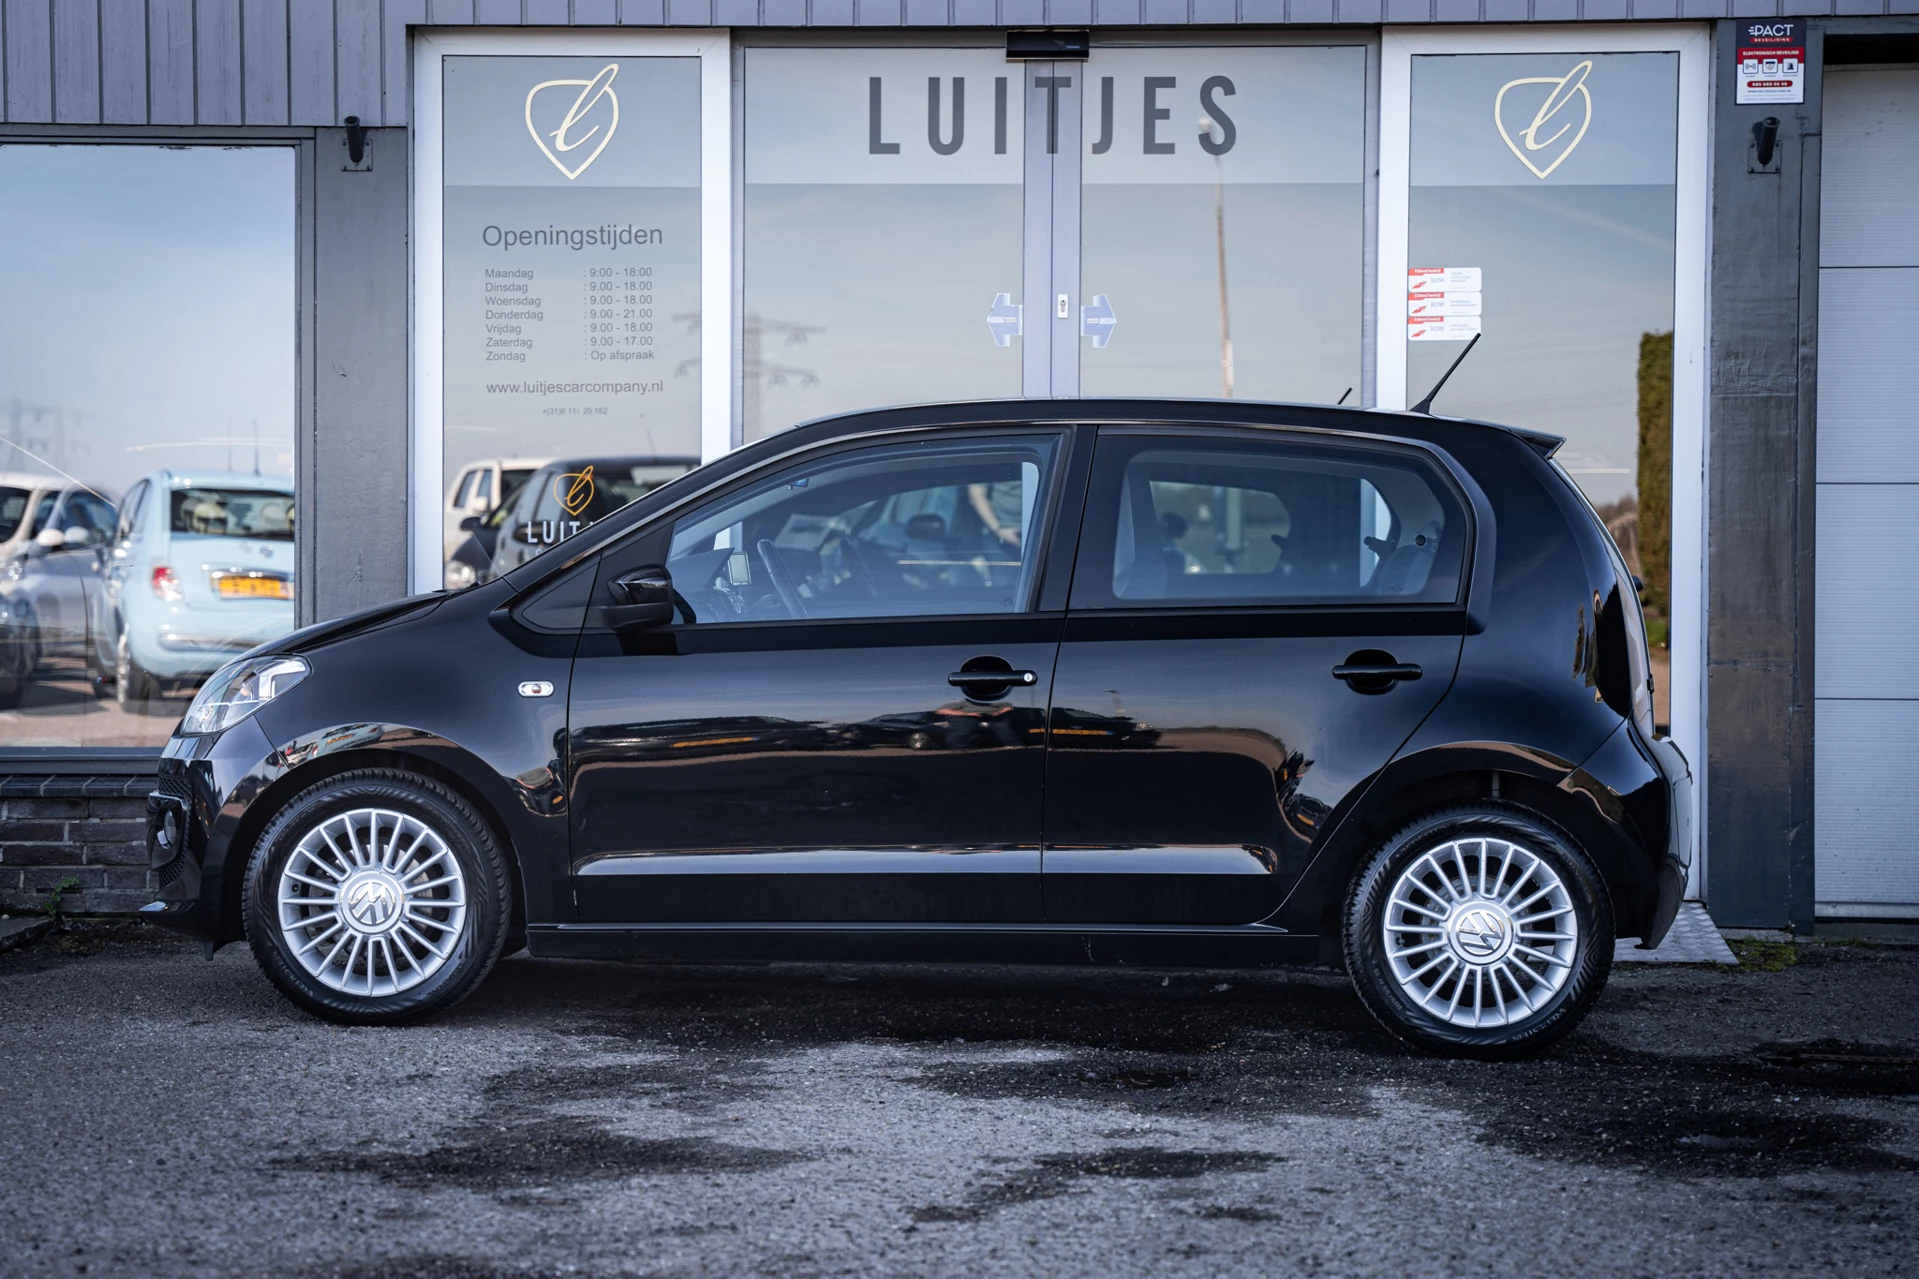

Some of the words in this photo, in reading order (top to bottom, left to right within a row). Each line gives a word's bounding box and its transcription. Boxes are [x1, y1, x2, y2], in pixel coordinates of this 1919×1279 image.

[1748, 24, 1794, 36] PACT
[869, 75, 1236, 156] LUITJES
[482, 224, 663, 251] Openingstijden
[485, 268, 534, 280] Maandag
[485, 282, 528, 294] Dinsdag
[590, 282, 613, 291] 9.00
[485, 296, 541, 307] Woensdag
[590, 295, 613, 305] 9.00
[485, 310, 544, 321] Donderdag
[590, 309, 613, 318] 9.00
[485, 324, 522, 335] Vrijdag
[590, 323, 613, 332] 9.00
[485, 337, 532, 349] Zaterdag
[590, 337, 613, 346] 9.00
[486, 351, 526, 363] Zondag
[591, 350, 606, 362] Op
[609, 350, 654, 362] afspraak
[486, 380, 663, 396] www.luitjescarcompany.nl
